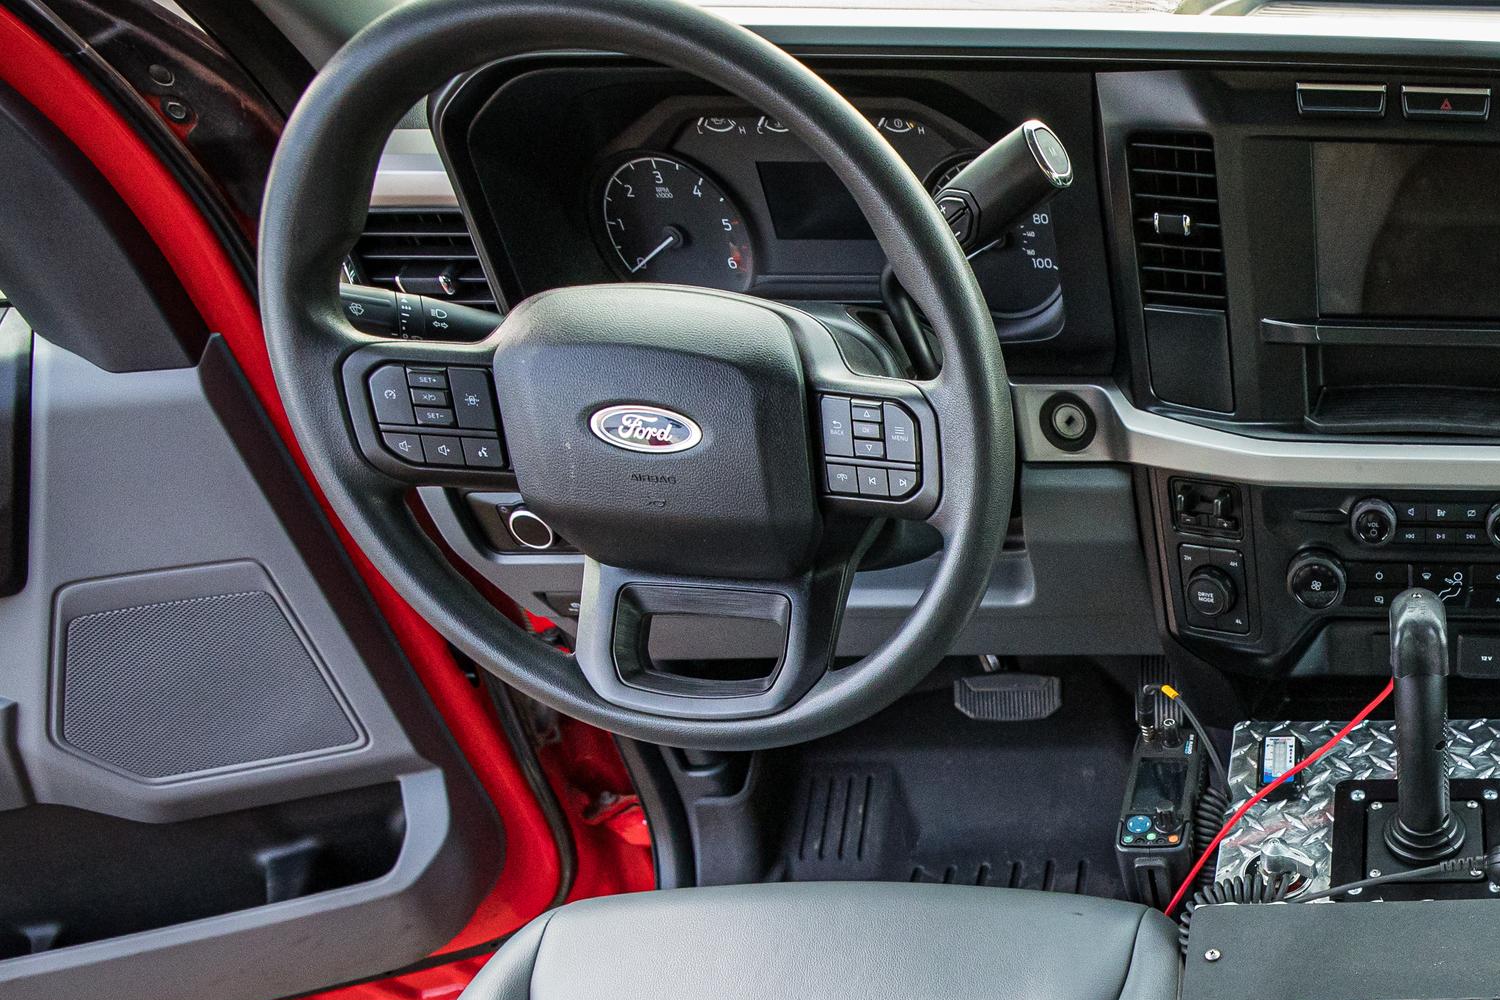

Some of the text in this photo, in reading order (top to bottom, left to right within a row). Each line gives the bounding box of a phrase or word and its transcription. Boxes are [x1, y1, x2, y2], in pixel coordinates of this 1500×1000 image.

[652, 171, 663, 184] 3
[624, 185, 635, 197] 2
[693, 185, 702, 198] 4
[1032, 213, 1049, 224] 80
[618, 219, 625, 231] 1
[722, 219, 732, 231] 5
[727, 257, 738, 269] 6
[1031, 258, 1052, 269] 100
[617, 414, 673, 441] Ford
[891, 434, 909, 442] MENU
[1198, 596, 1214, 604] MODE
